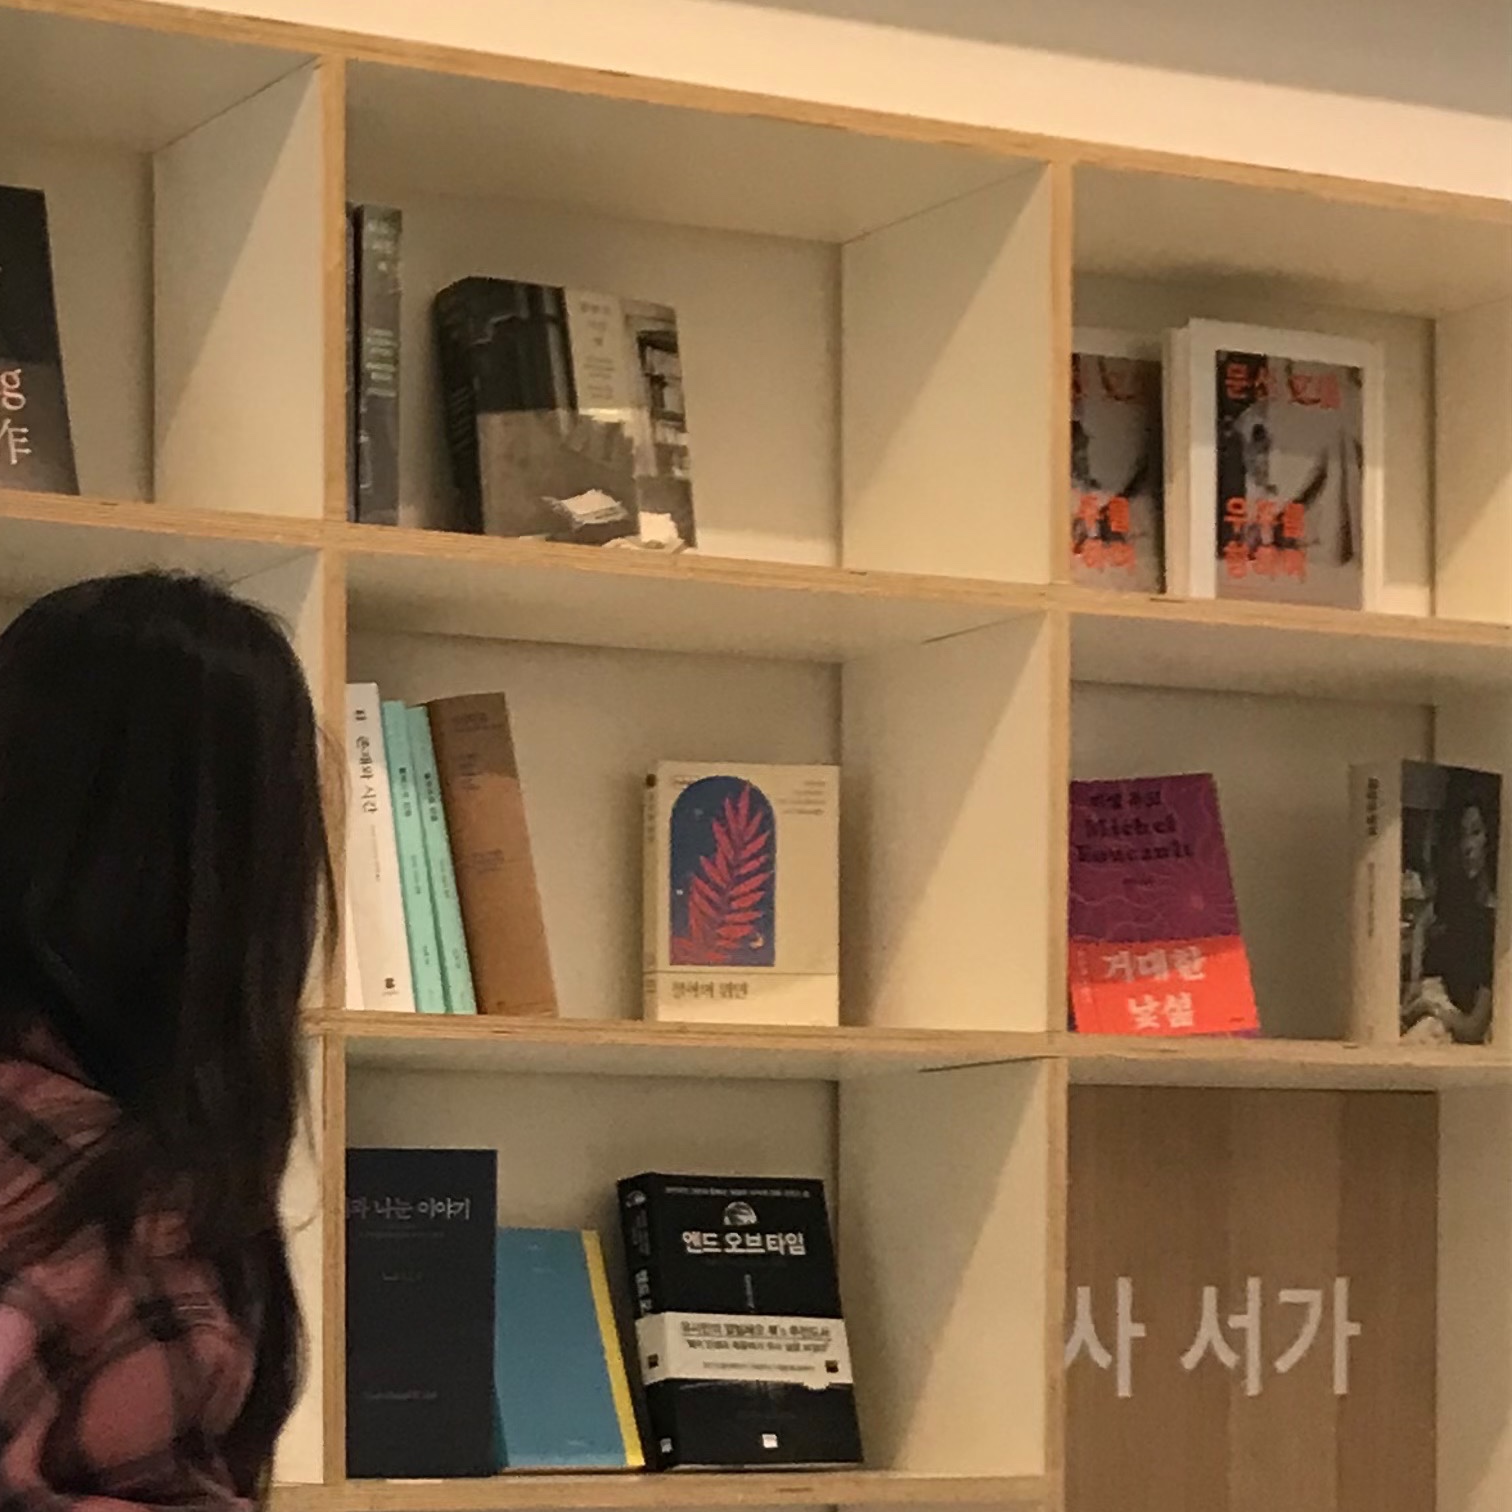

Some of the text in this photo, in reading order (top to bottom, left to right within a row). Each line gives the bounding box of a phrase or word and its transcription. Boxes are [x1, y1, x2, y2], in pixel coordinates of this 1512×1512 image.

[417, 1196, 472, 1221] 이야기
[1065, 1275, 1362, 1398] 사 서가
